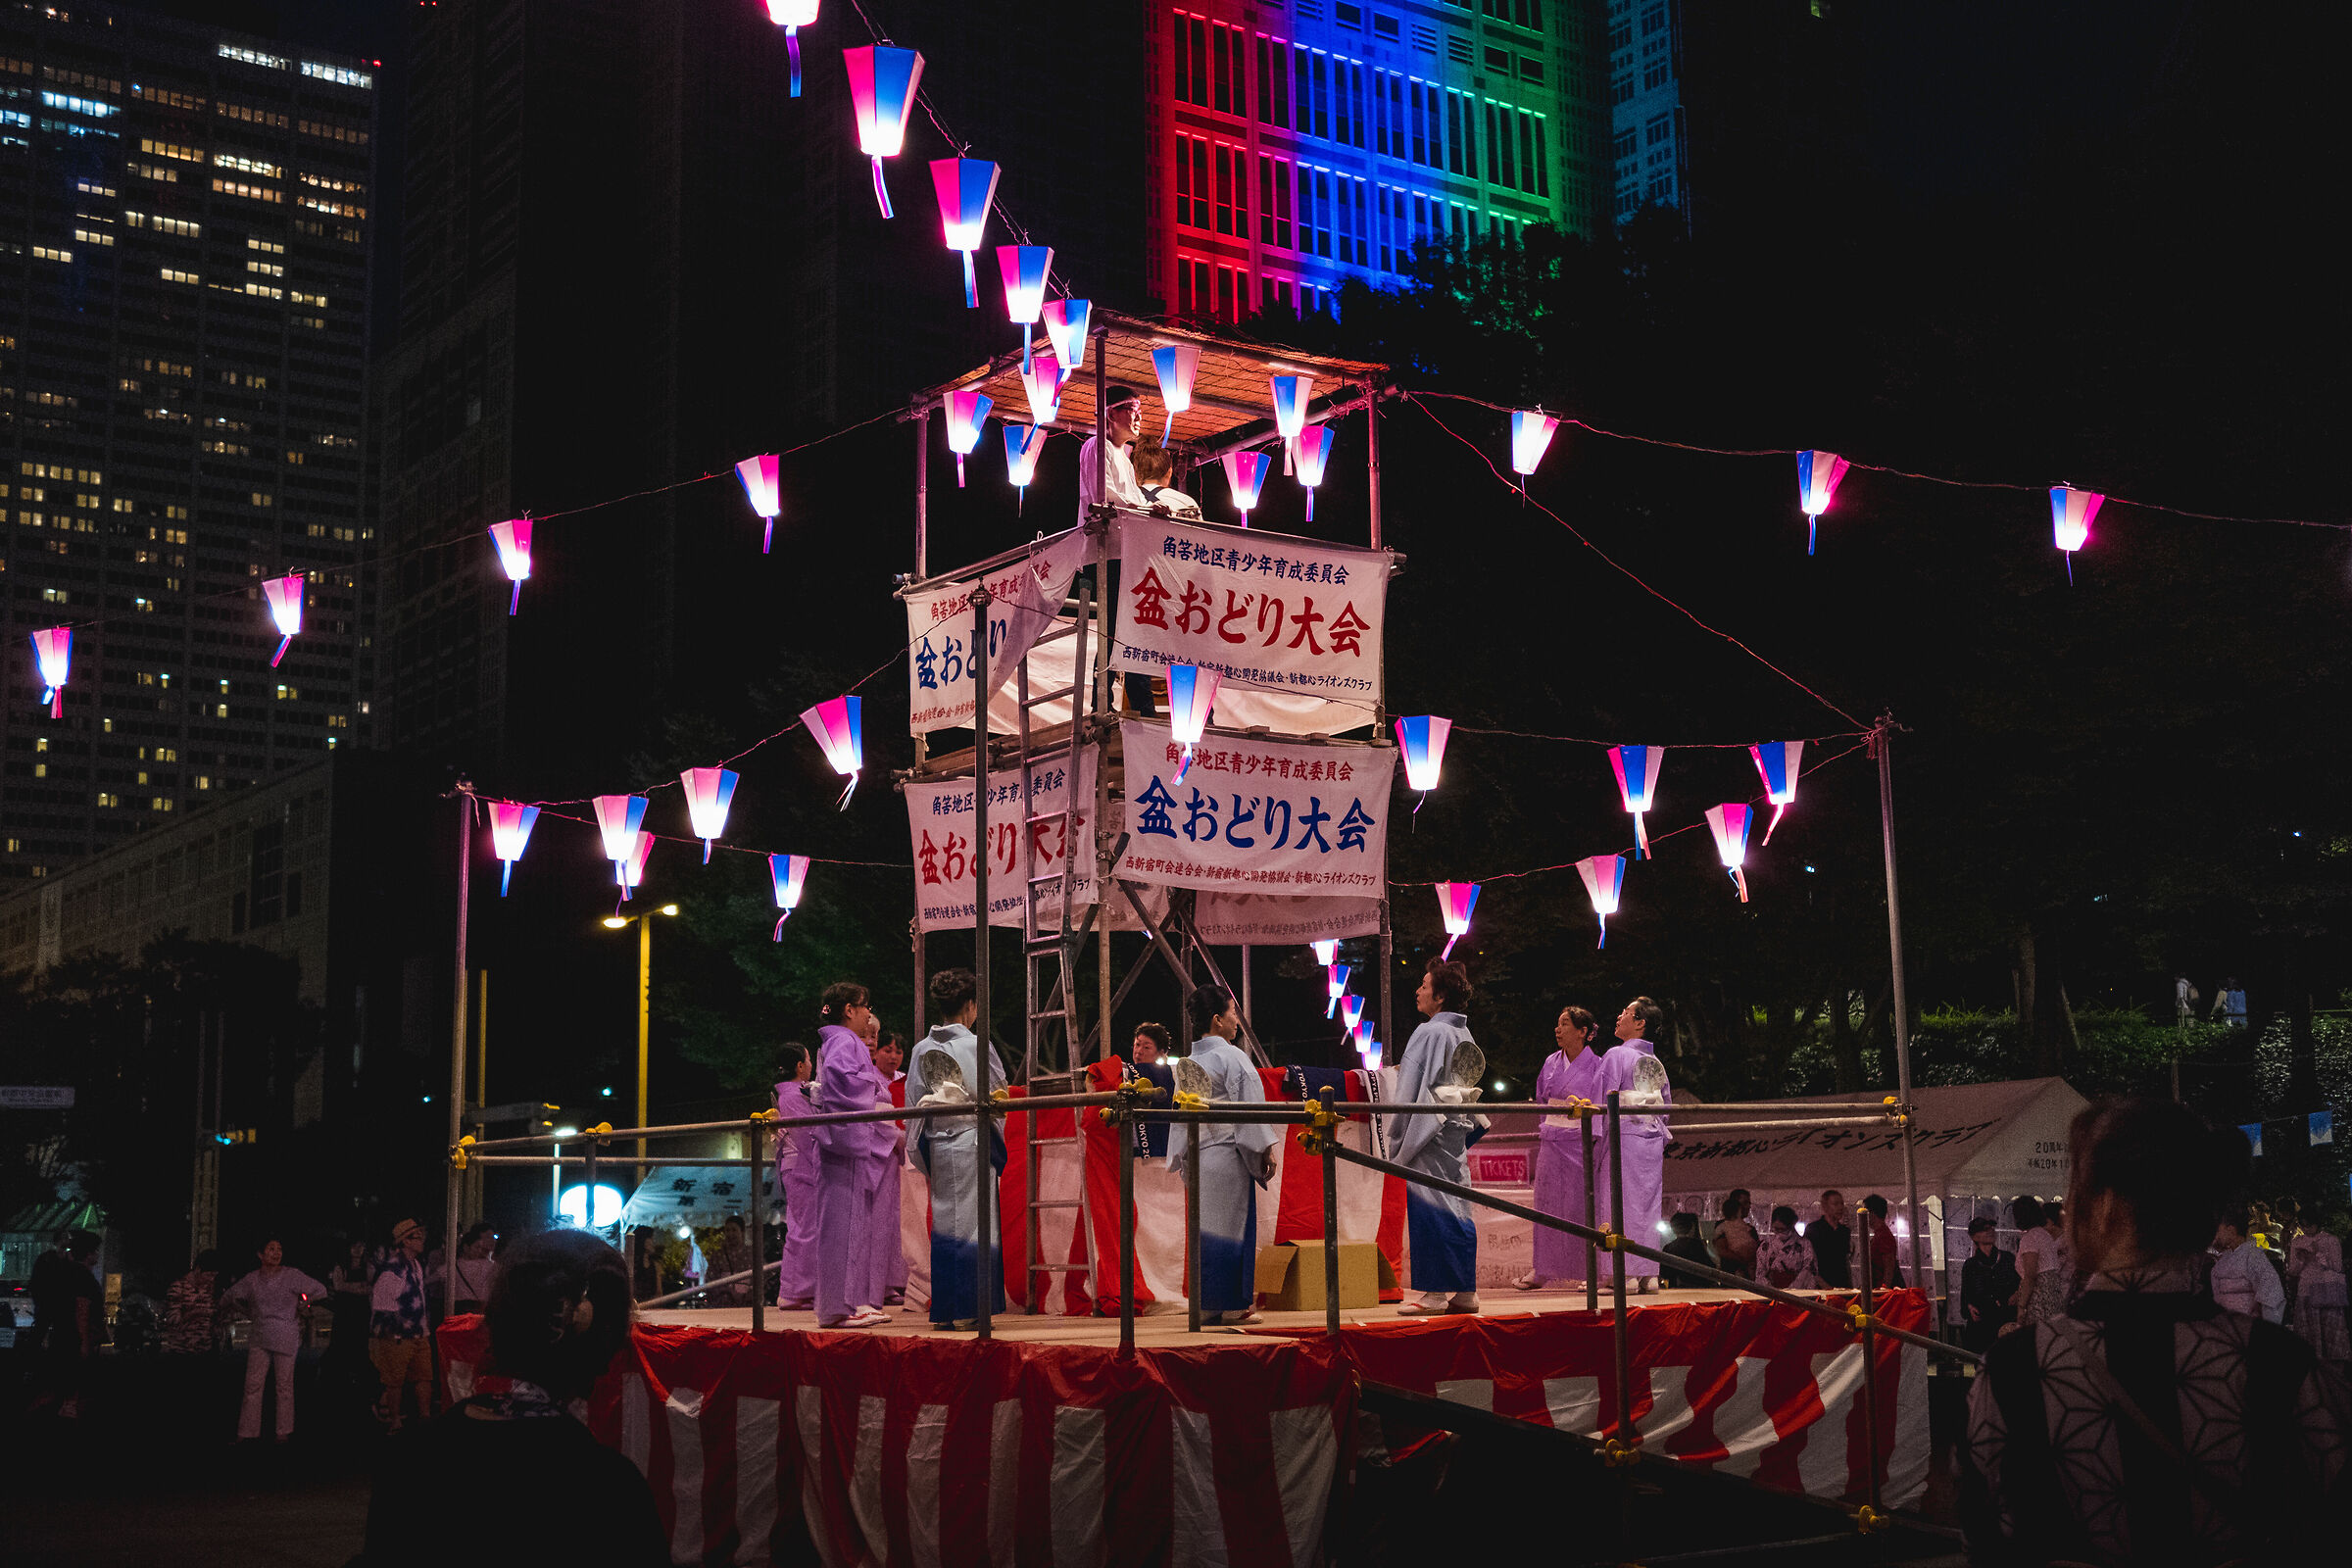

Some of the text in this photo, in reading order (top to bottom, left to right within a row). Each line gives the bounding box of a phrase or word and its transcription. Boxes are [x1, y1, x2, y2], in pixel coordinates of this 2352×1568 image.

[1162, 535, 1350, 585] 角筈地区青少年育成委員会
[1130, 566, 1371, 658] 盆おどり大会
[933, 768, 1065, 815] 角筈地区少年育委員会
[1135, 774, 1376, 854] 盆おどり大会
[1298, 1072, 1309, 1099] TOKYO
[1138, 1121, 1150, 1149] OKYO
